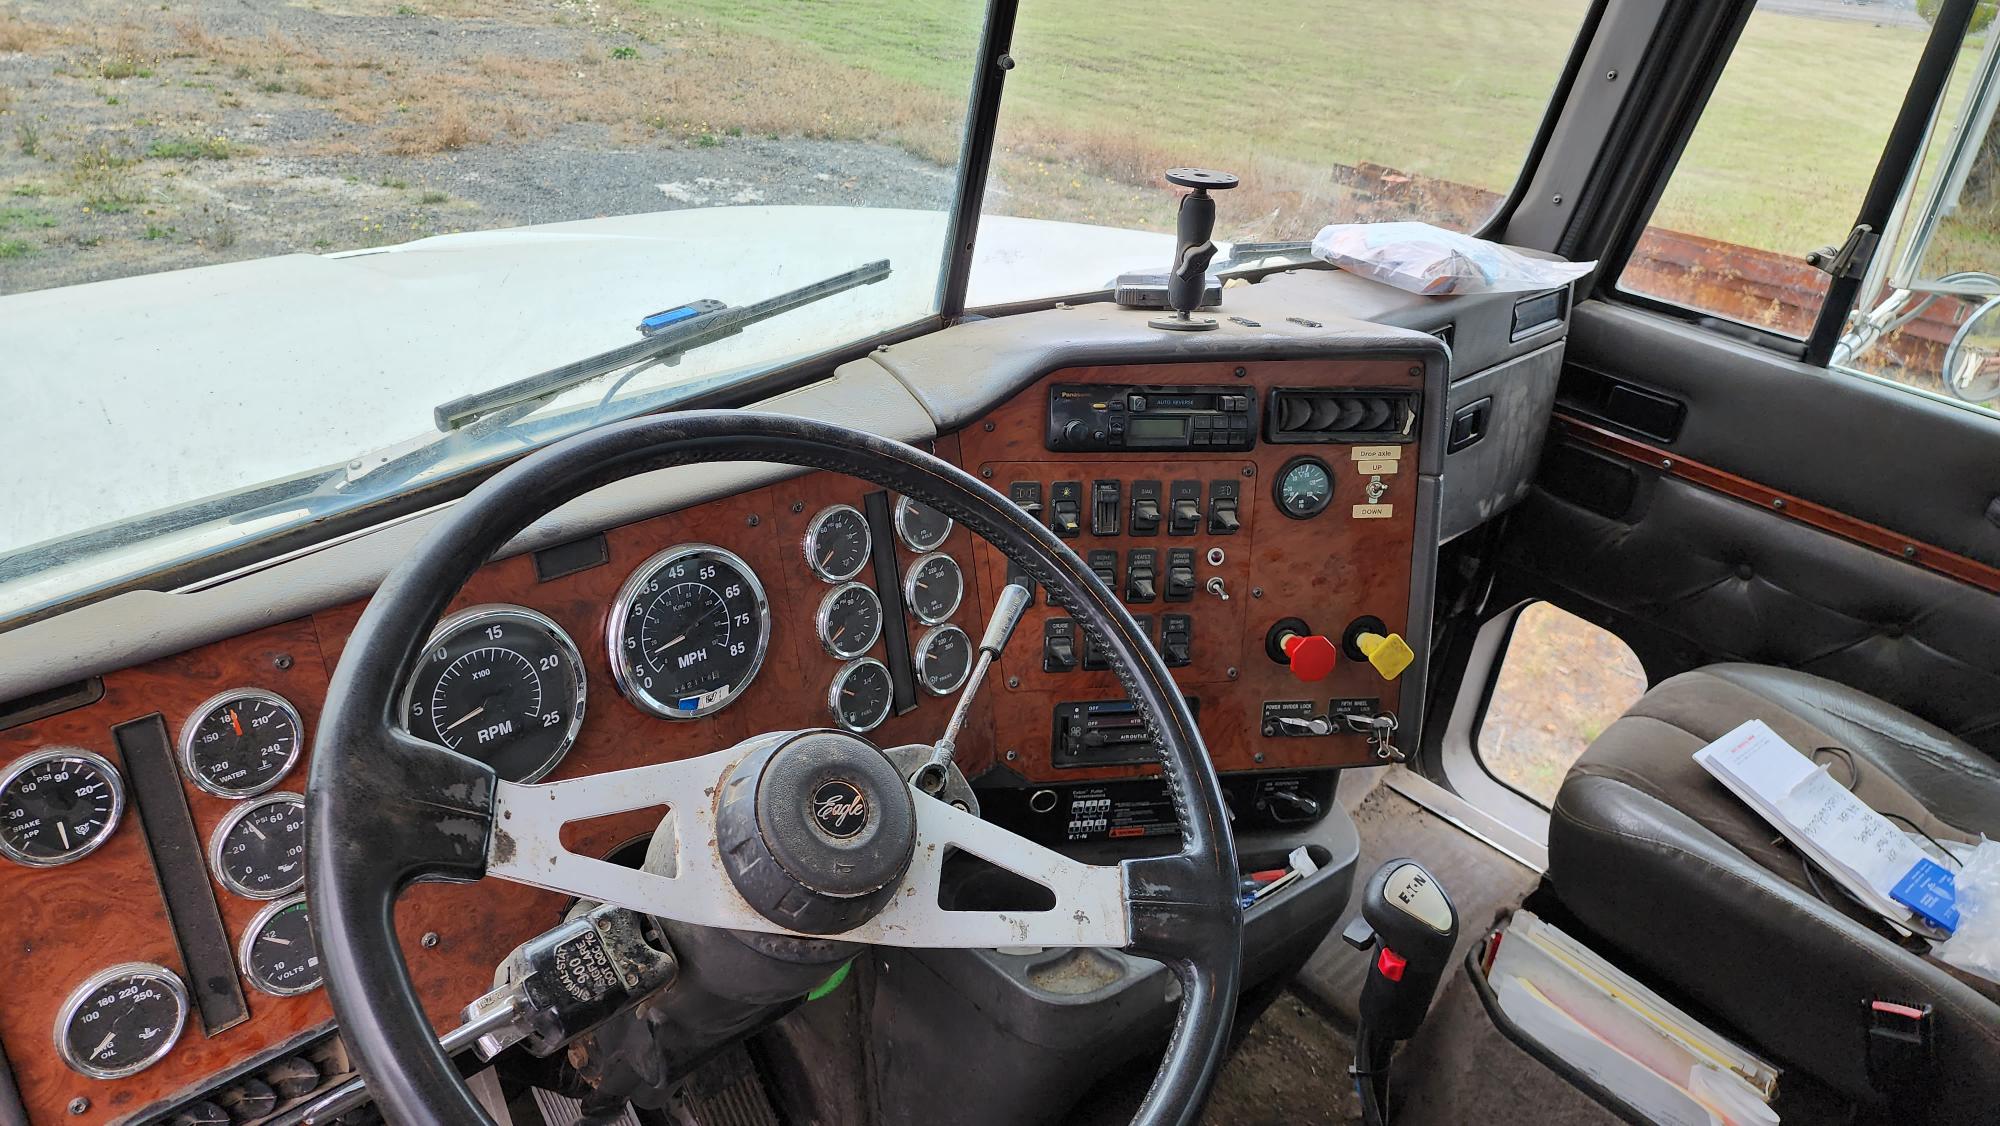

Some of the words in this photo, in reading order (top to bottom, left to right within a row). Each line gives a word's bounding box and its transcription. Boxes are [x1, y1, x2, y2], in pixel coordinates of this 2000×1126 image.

[669, 565, 685, 578] 45
[700, 566, 716, 580] 55
[726, 585, 740, 598] 65
[734, 613, 749, 627] 75
[485, 624, 503, 641] 15
[730, 642, 745, 656] 85
[540, 654, 559, 671] 20
[678, 649, 707, 668] MPH
[636, 665, 644, 676] 5
[644, 677, 652, 688] 0
[413, 702, 423, 716] 5
[252, 716, 268, 727] 210
[543, 711, 560, 727] 25
[477, 720, 513, 743] RPM
[202, 733, 219, 743] 150
[261, 744, 280, 756] 240
[211, 761, 229, 773] 120
[37, 774, 52, 783] PSI
[54, 772, 69, 782] 90
[220, 769, 247, 782] WATER
[22, 783, 36, 793] 60
[75, 785, 93, 797] 120
[9, 809, 24, 819] 30
[814, 795, 864, 827] Eagle
[270, 813, 283, 823] 60
[13, 819, 40, 832] BRAKE
[287, 821, 299, 832] 80
[24, 830, 39, 839] APP
[233, 844, 245, 854] 20
[258, 874, 271, 882] OIL
[274, 962, 284, 970] 10
[570, 958, 589, 983] 900
[277, 966, 304, 980] VOLTS
[119, 986, 138, 999] 220
[133, 990, 153, 1002] 250
[97, 995, 115, 1007] 180
[81, 1011, 100, 1023] 100
[101, 1049, 117, 1059] OIL
